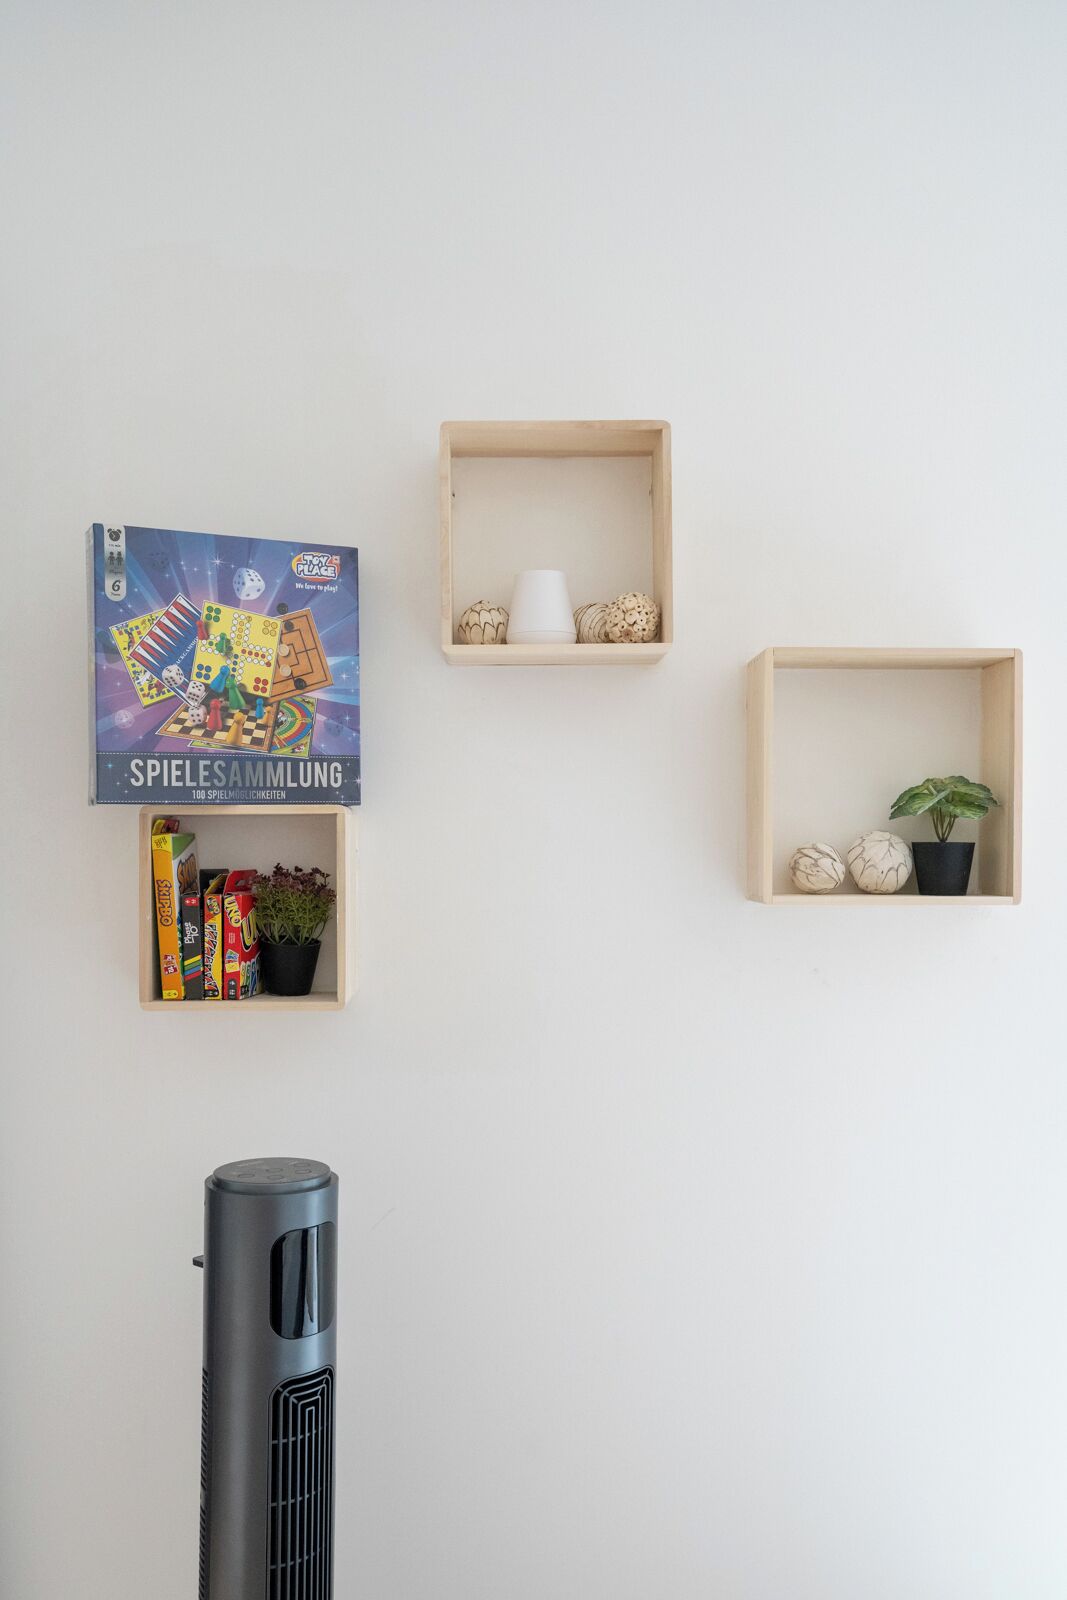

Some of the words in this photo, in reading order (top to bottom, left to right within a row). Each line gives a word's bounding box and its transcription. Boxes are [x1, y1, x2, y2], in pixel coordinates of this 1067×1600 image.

[302, 554, 330, 567] TOY
[297, 563, 336, 578] PLACE
[130, 759, 343, 788] SPIELESAMMLUNG
[192, 790, 206, 800] 100
[207, 789, 286, 800] SPIELMÖGLICHKEITEN
[224, 894, 241, 927] UNO
[184, 922, 192, 944] Phase
